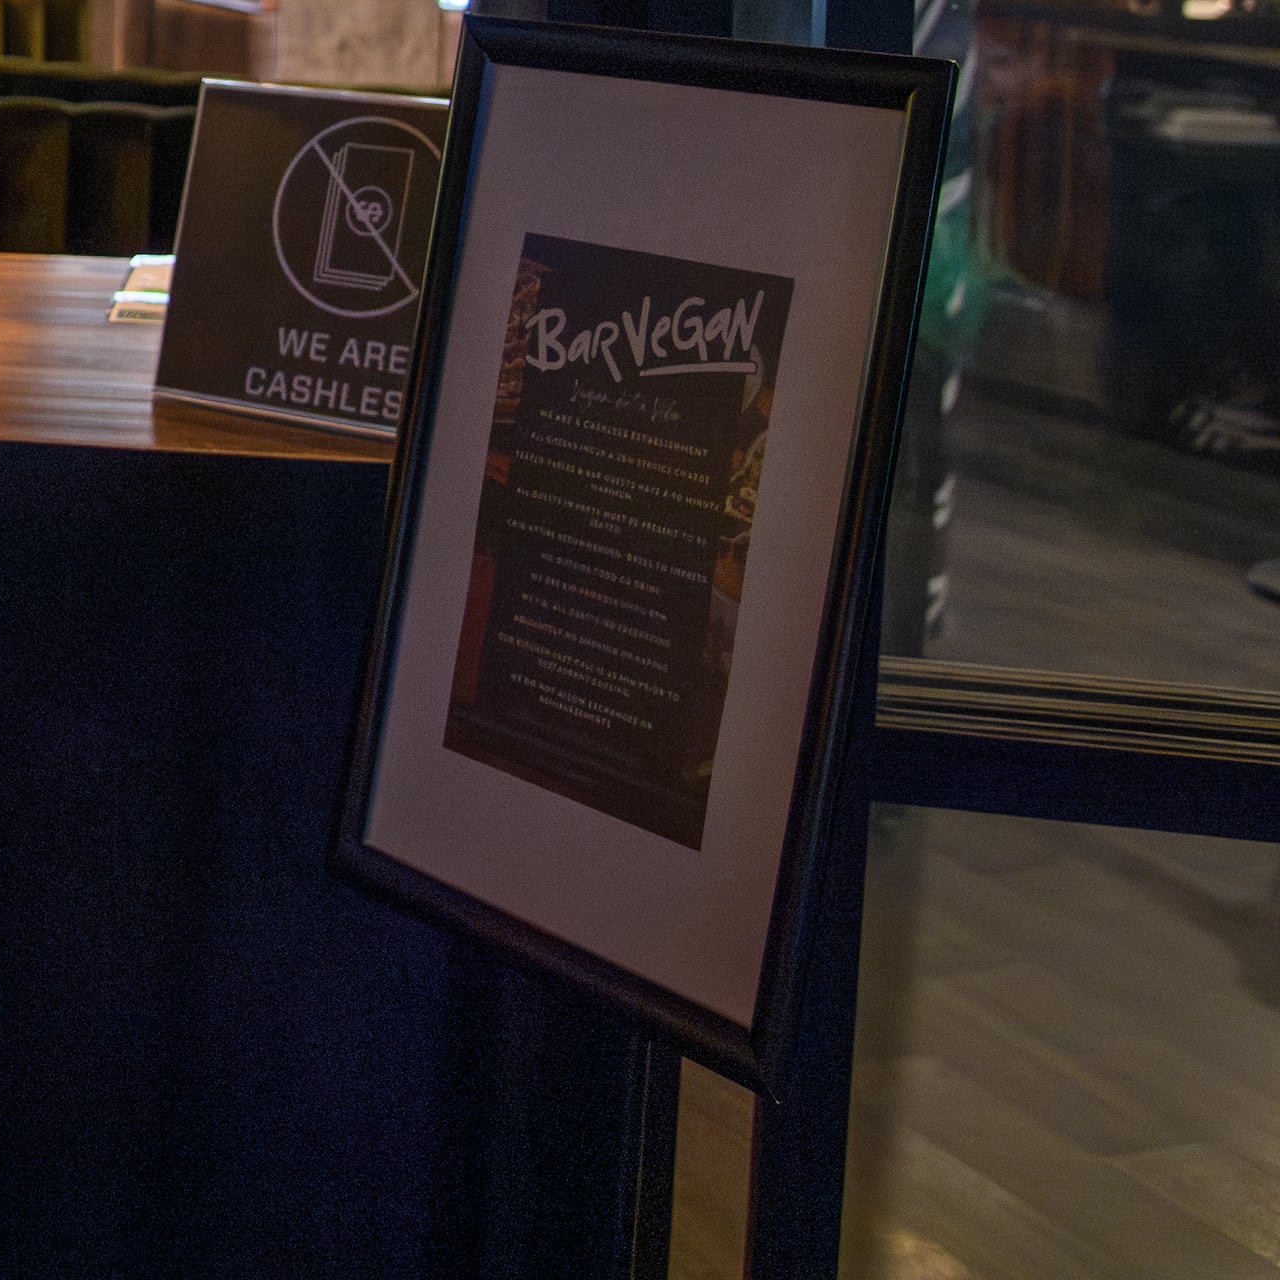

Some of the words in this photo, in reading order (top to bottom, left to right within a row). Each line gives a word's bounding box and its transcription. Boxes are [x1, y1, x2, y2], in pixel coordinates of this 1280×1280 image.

[277, 326, 331, 363] WE
[339, 337, 411, 376] ARE
[243, 366, 405, 420] CASHLES
[554, 412, 572, 424] ARE
[630, 431, 708, 458] ESTABLISHMENT
